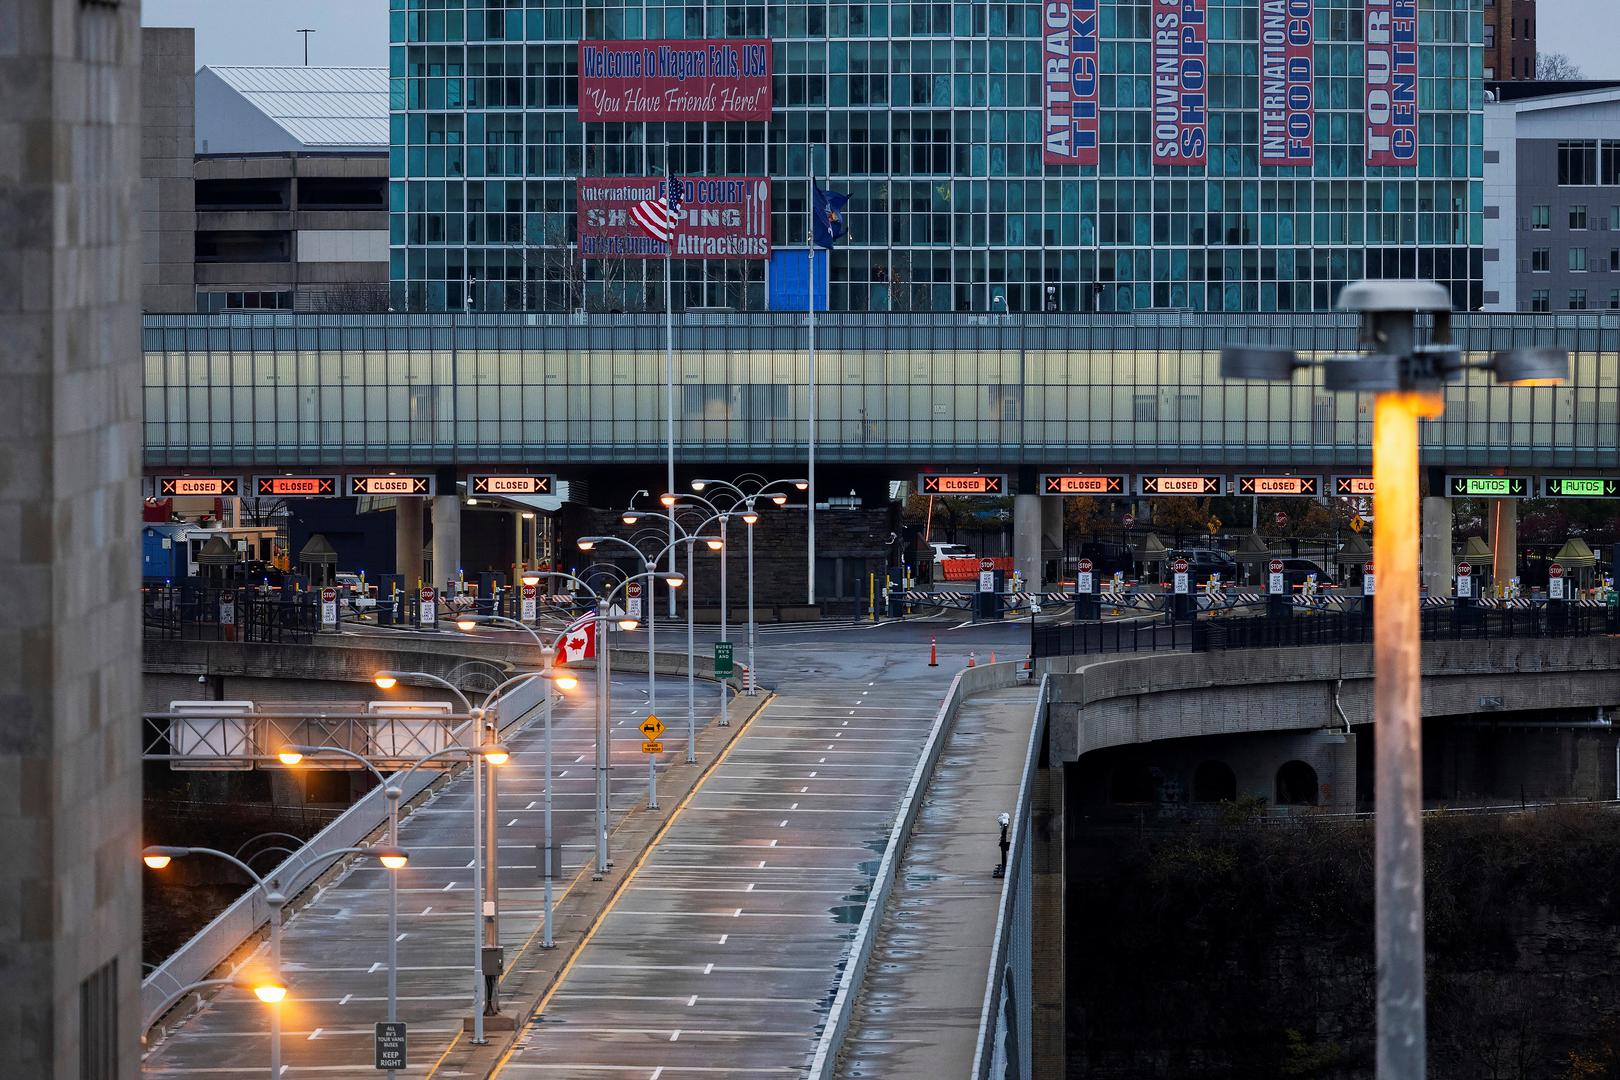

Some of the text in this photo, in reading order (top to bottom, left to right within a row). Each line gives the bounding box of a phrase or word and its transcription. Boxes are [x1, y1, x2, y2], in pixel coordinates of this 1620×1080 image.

[583, 45, 767, 81] Welcome to Niagara Falls, USA
[586, 83, 767, 116] "You Have Friends Here!"
[1046, 2, 1070, 157] ATTRAC
[1156, 13, 1178, 157] SOUVENIRS
[1181, 0, 1205, 158] SHOPP
[1263, 0, 1286, 158] INTERNATIONA
[1288, 0, 1311, 158] FOOD CO
[1392, 0, 1415, 159] CENTER
[658, 181, 694, 204] FD
[698, 180, 744, 203] COURT
[677, 233, 767, 255] Attractions
[1472, 481, 1504, 490] AUTOS
[1566, 482, 1599, 491] AUTOS
